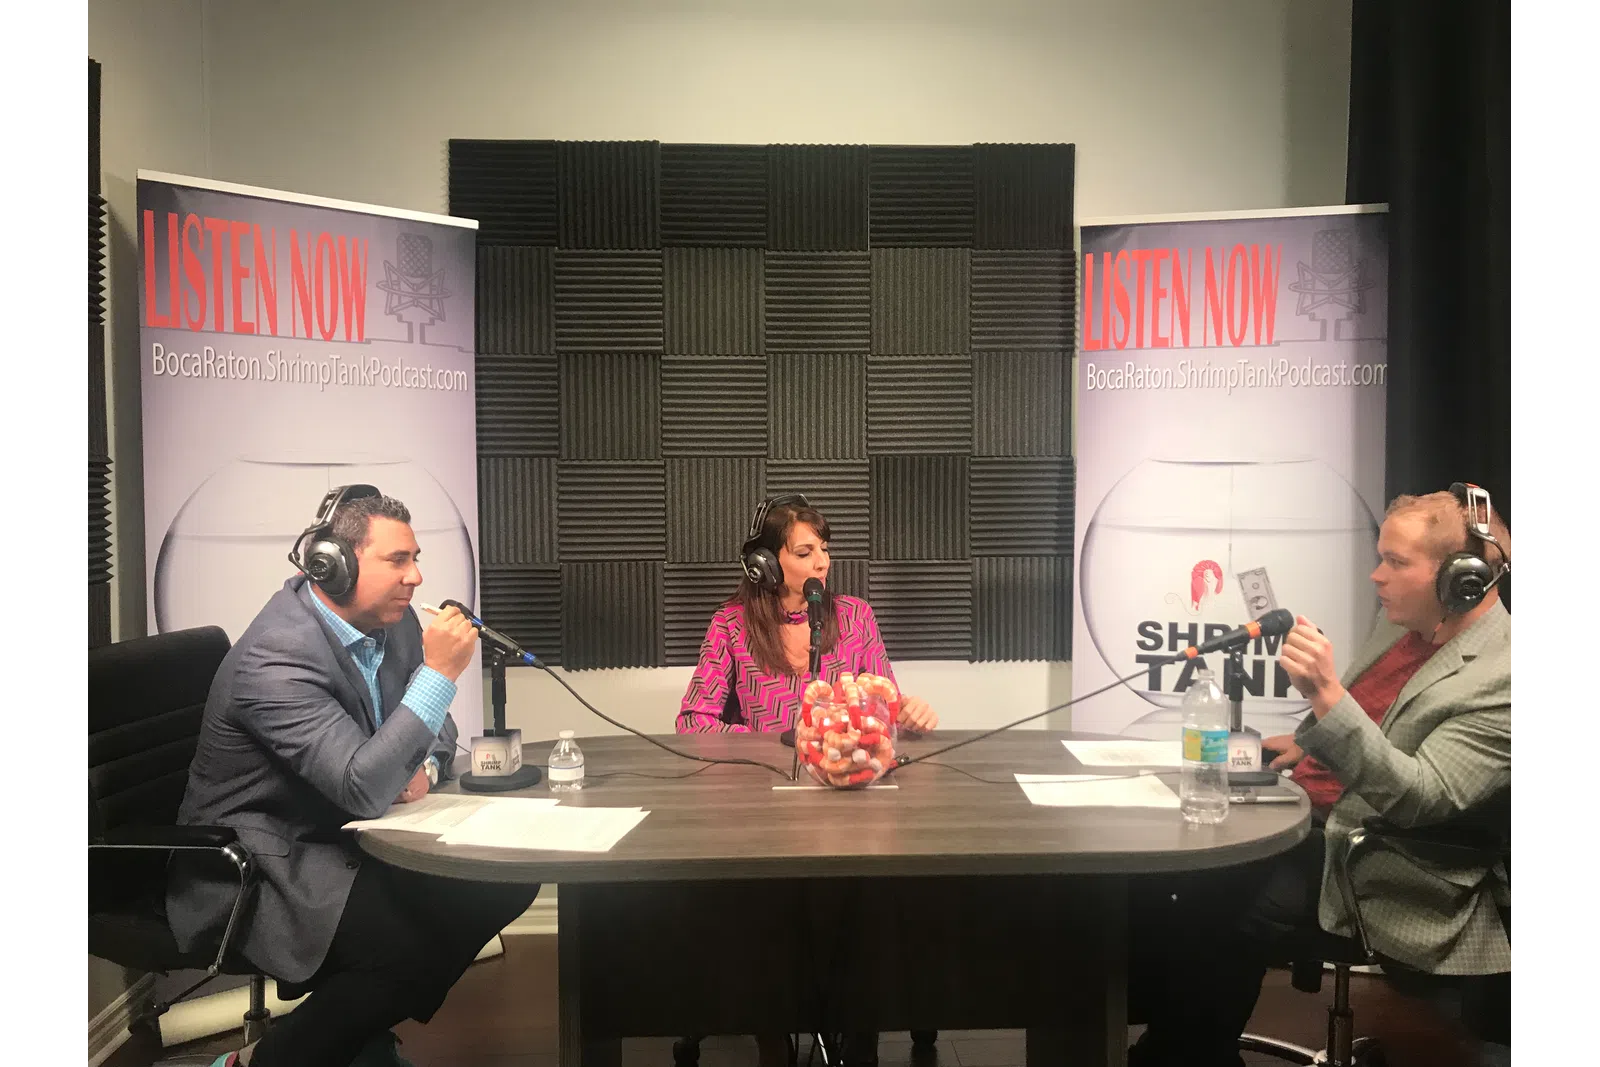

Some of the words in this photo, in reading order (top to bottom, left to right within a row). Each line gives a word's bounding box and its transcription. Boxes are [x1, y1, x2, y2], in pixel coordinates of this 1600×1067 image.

[143, 210, 278, 337] LISTEN
[290, 228, 369, 342] NOW
[1084, 247, 1193, 351] LISTEN
[1203, 243, 1283, 348] NOW
[152, 342, 468, 392] BocaRaton.ShrimpTankPodcast.com
[1136, 620, 1324, 656] SHRM
